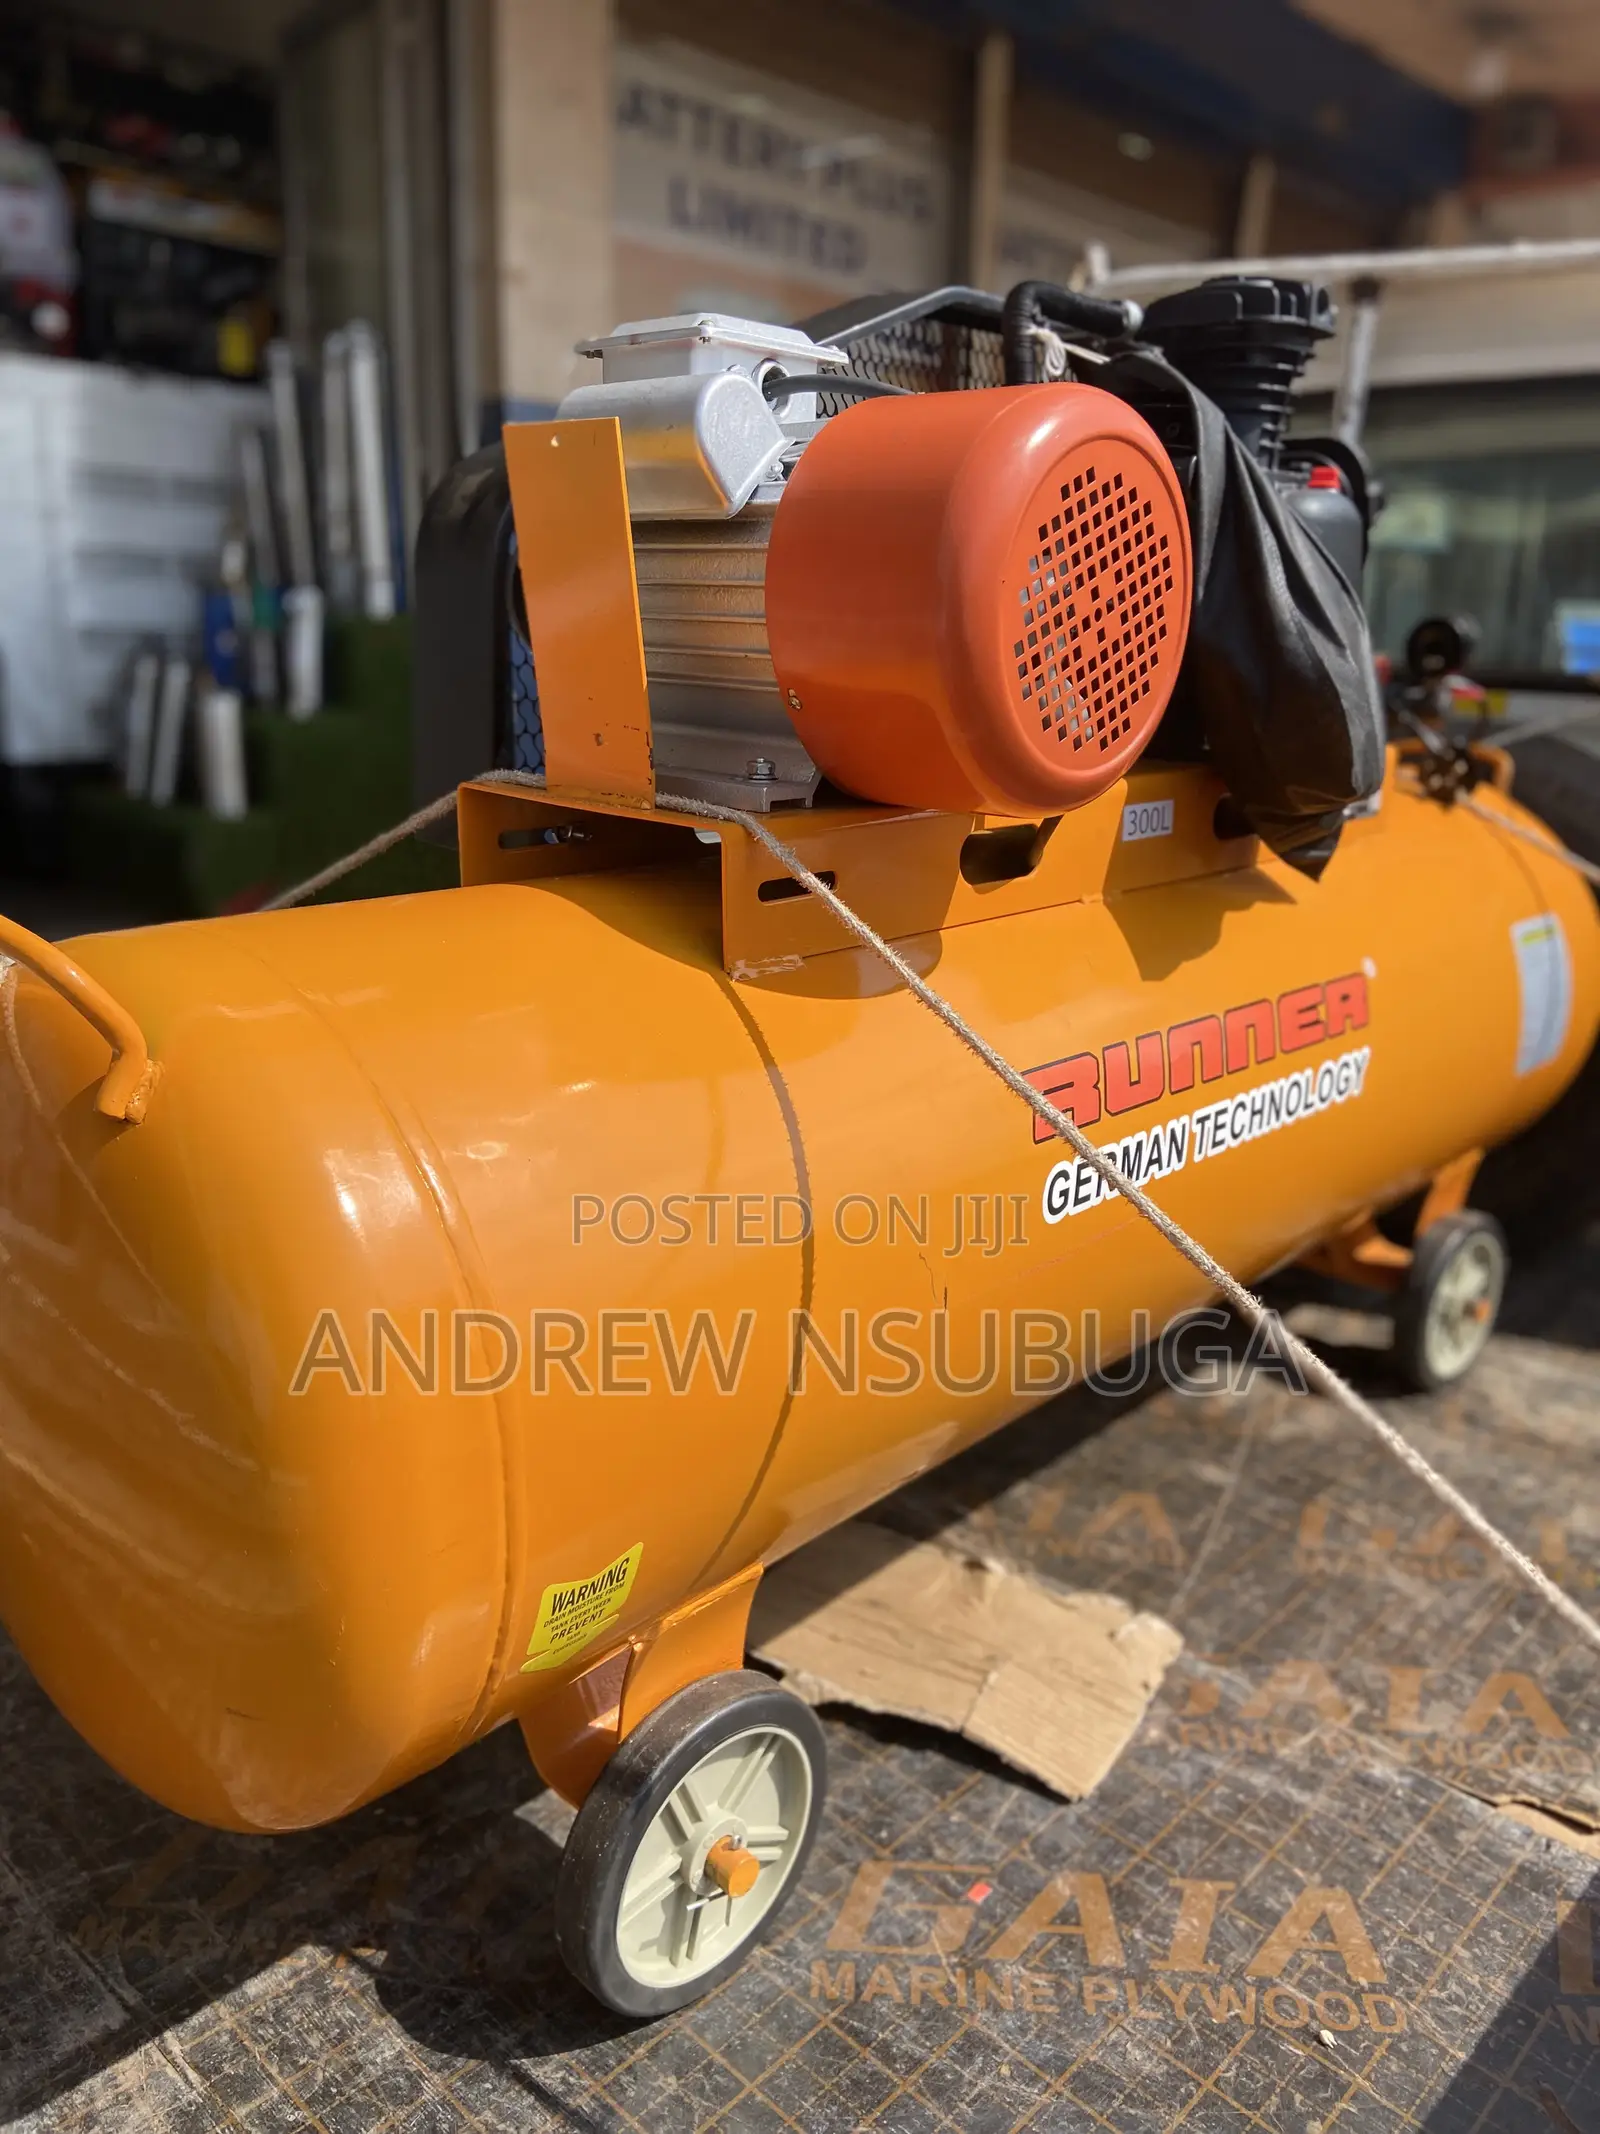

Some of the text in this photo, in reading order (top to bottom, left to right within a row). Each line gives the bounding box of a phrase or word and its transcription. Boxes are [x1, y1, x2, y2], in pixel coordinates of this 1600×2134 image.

[1127, 806, 1170, 836] 300L
[1021, 971, 1370, 1145] RUNNER
[1194, 1057, 1367, 1158] TECHNOLOGY
[543, 1581, 626, 1628] DRAIN MOISTURE FROM
[550, 1597, 612, 1632] TANK EVERY WEEK
[551, 1557, 630, 1616] WARNING
[549, 1608, 605, 1645] PREVENT
[825, 1859, 1388, 1984] GAIA
[810, 1959, 1408, 2034] MARINE PLYWOOD
